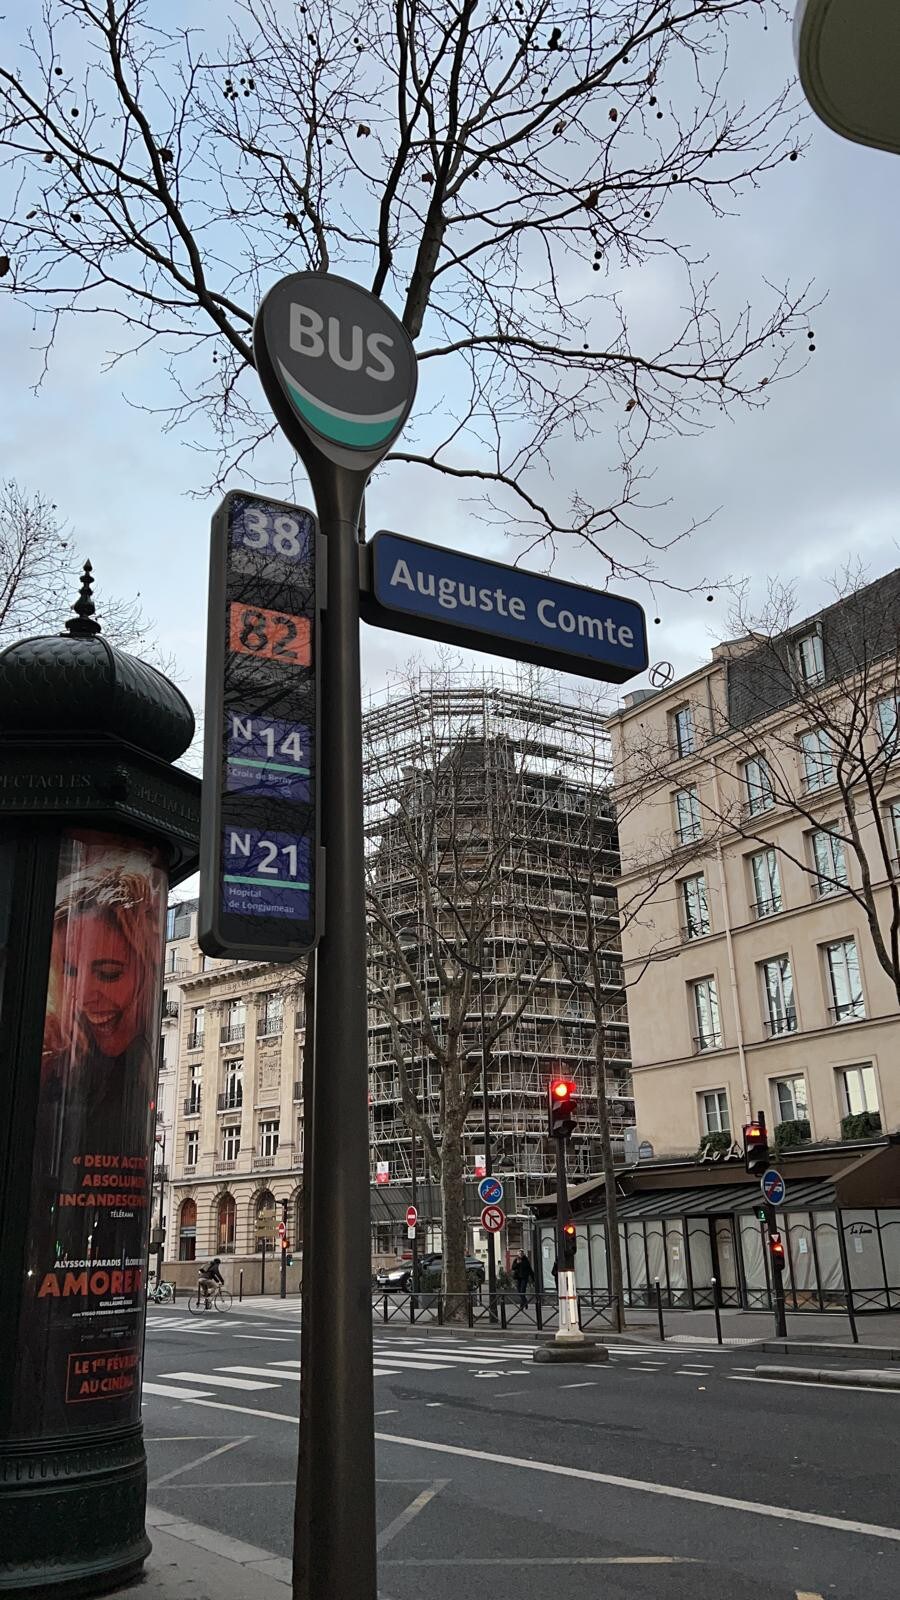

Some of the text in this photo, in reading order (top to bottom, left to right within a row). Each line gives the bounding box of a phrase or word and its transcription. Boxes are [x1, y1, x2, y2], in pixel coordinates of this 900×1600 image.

[289, 302, 396, 382] BUS
[243, 509, 300, 556] 38
[390, 559, 635, 648] Auguste Comte
[240, 610, 298, 659] 82
[232, 716, 303, 761] N 14
[232, 768, 254, 779] Croix
[230, 832, 297, 876] N 21
[228, 900, 295, 912] de Longjumeau
[84, 1154, 119, 1168] DEUX
[54, 1259, 91, 1269] ALYSSON
[92, 1259, 121, 1267] PARADIS
[75, 1360, 90, 1374] LE
[80, 1380, 99, 1394] AU
